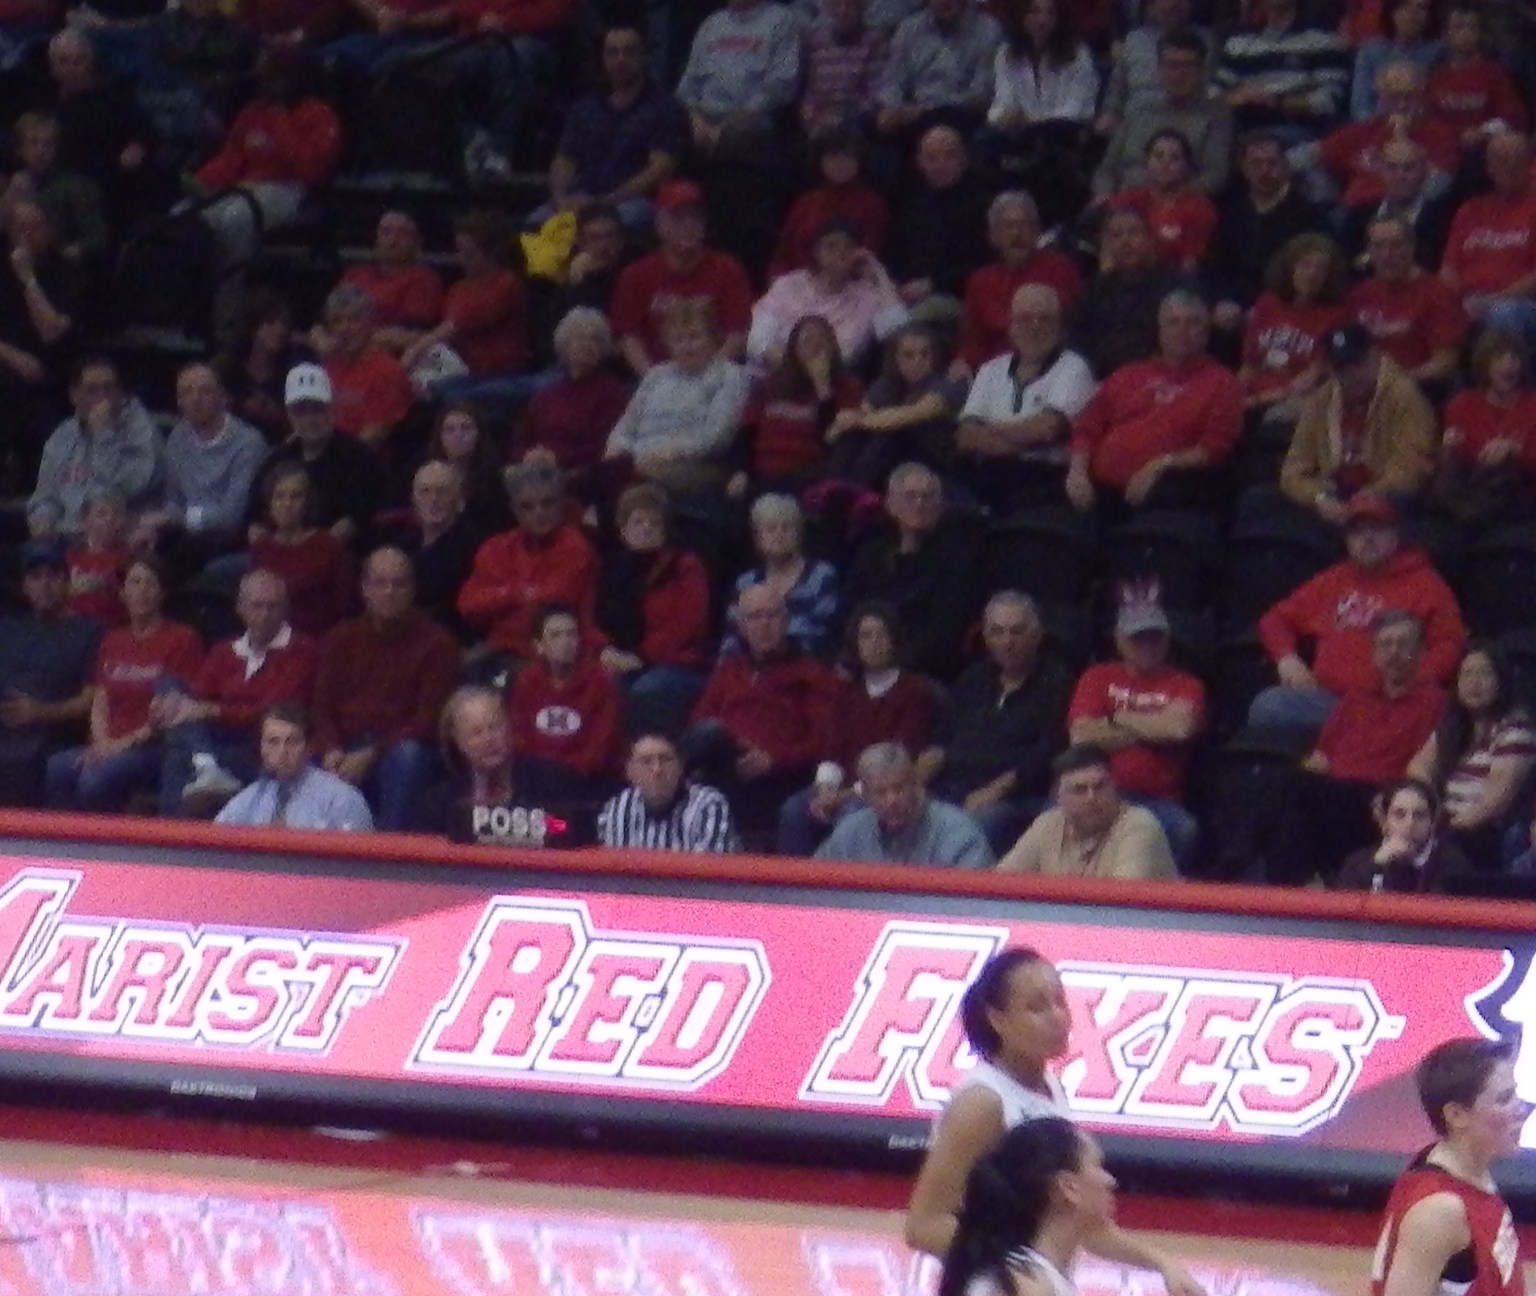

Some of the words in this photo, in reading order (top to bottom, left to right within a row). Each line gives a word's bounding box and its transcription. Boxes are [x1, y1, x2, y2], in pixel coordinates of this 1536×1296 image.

[472, 805, 547, 837] POSS
[404, 895, 773, 1092] RED
[797, 920, 1390, 1137] FXES
